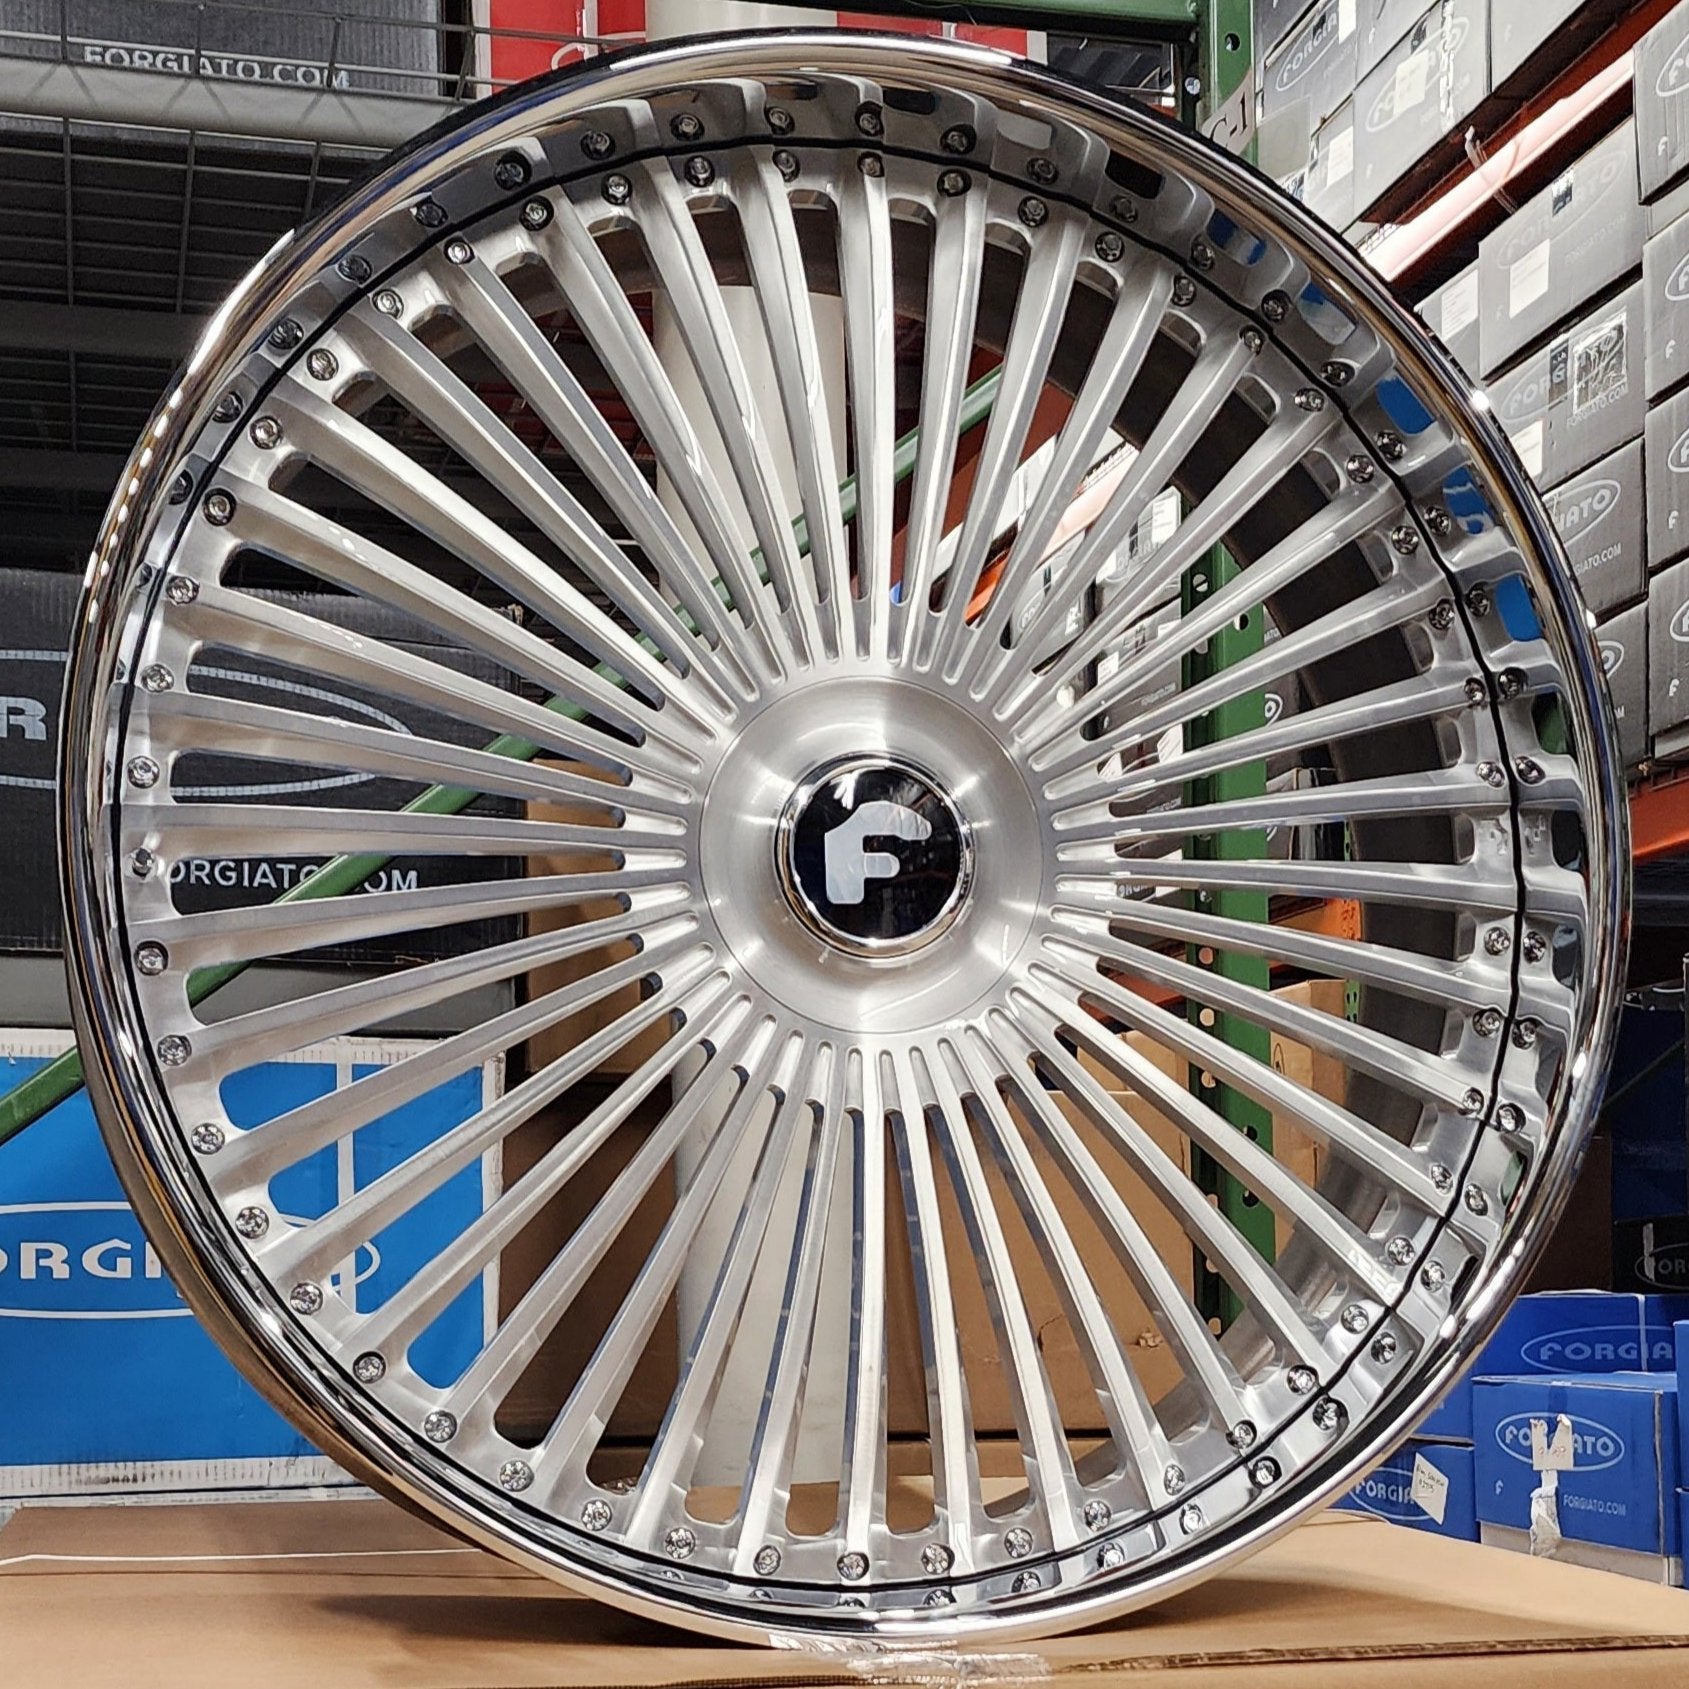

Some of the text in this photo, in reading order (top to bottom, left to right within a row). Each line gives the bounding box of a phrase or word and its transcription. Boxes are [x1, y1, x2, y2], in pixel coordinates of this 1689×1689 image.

[84, 45, 350, 89] FORGIATO.COM
[0, 1239, 162, 1280] RGI
[1563, 1493, 1627, 1516] FORGIATO.COM
